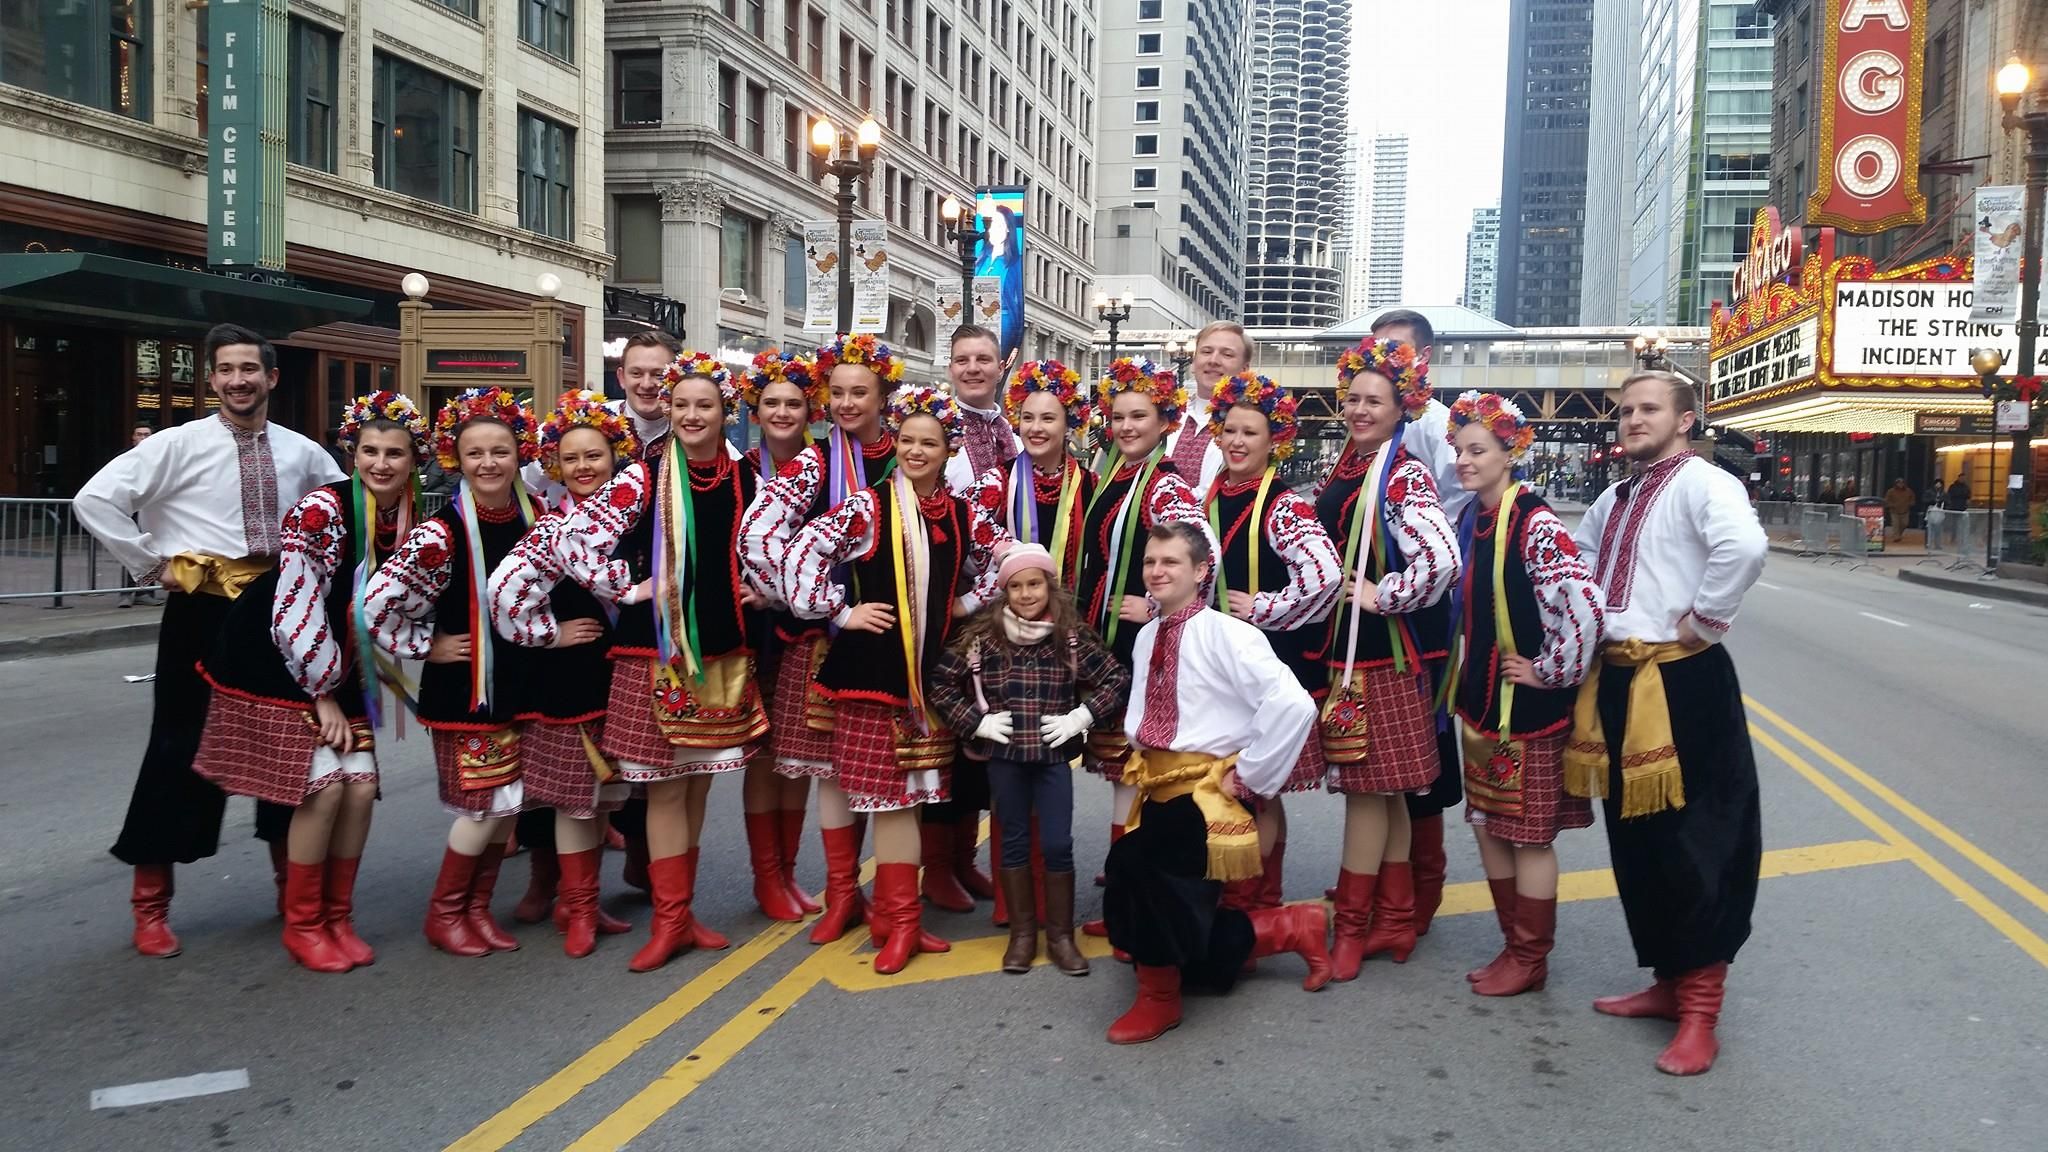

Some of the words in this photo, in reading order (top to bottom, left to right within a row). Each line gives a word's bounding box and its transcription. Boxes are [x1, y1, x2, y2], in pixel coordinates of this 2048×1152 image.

[223, 32, 238, 110] FILM
[223, 126, 238, 247] CENTER
[1733, 225, 1792, 301] CHICAGO
[1838, 290, 1935, 307] MADISON
[1948, 290, 1974, 307] HO
[1878, 319, 1917, 337] THE
[1928, 319, 2003, 337] STRING
[1862, 347, 1957, 365] INCIDENT
